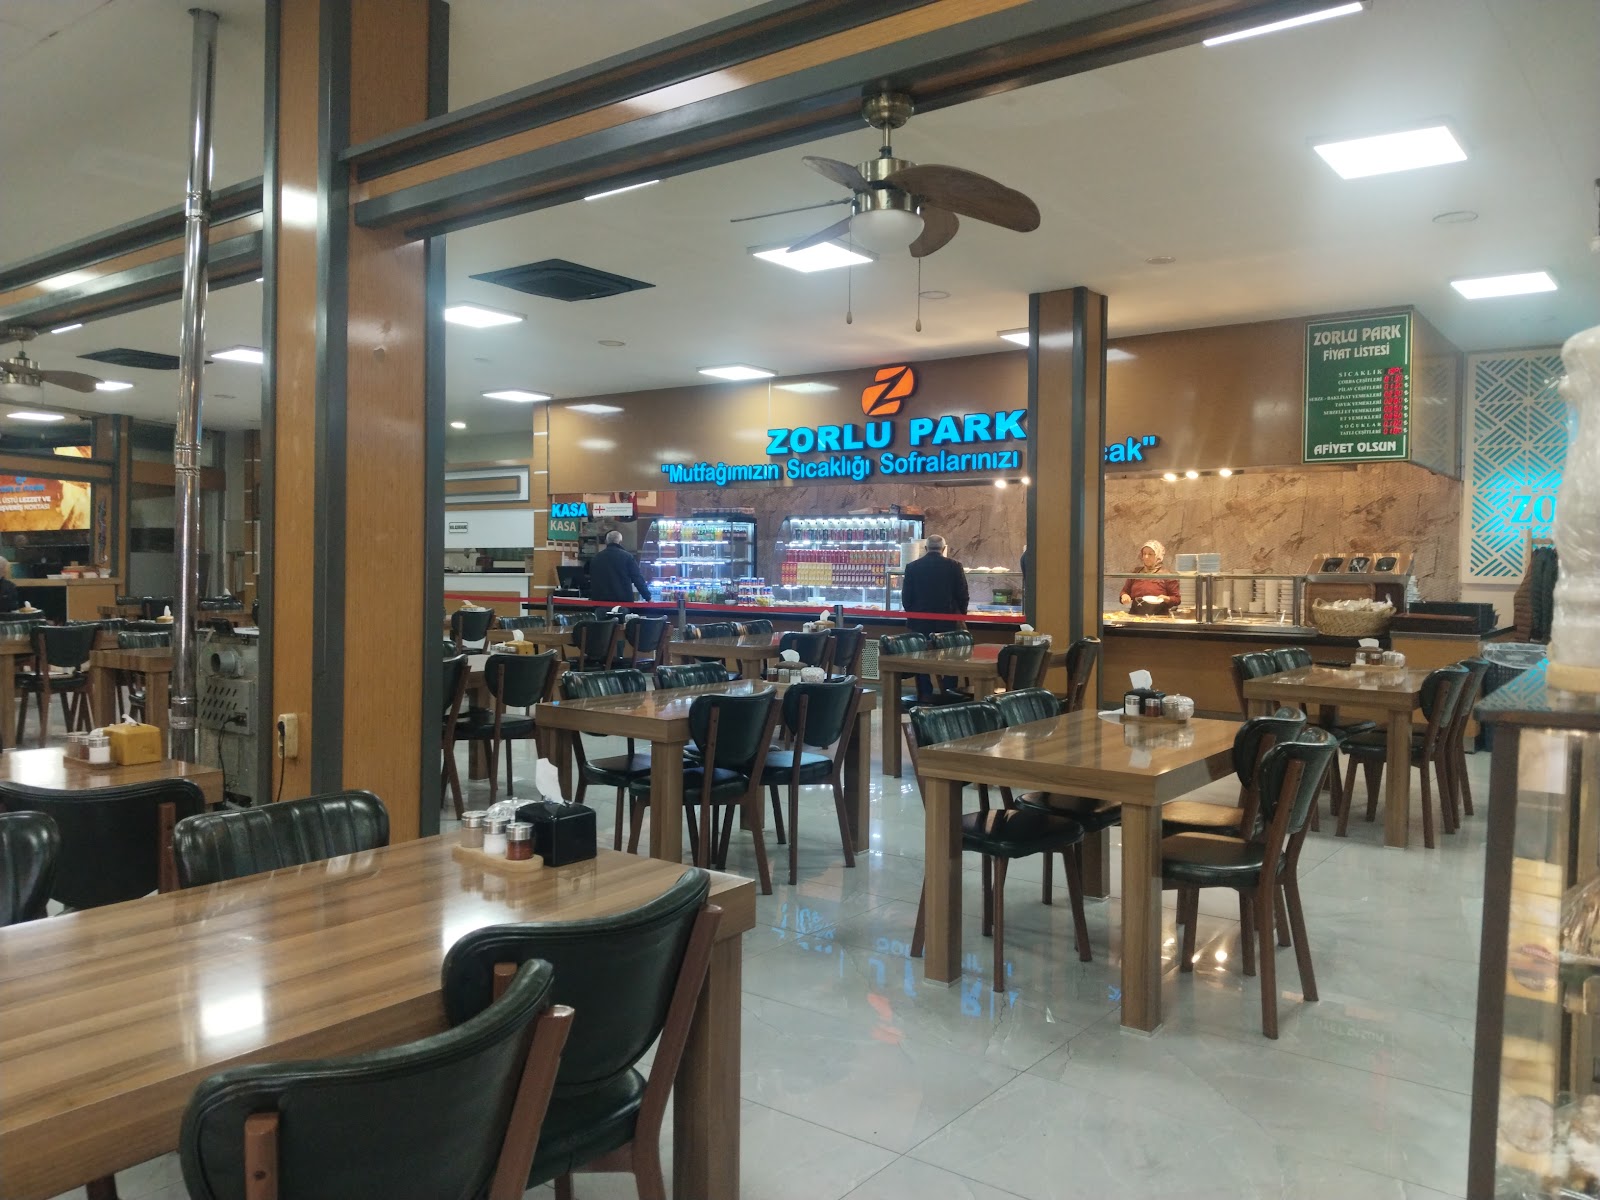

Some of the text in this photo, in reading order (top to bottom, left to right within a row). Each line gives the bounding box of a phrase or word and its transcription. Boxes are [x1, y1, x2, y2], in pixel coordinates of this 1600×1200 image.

[1313, 324, 1402, 346] ZORLU PARK
[1323, 342, 1390, 361] FİYAT LİSTESİ
[766, 409, 1028, 455] ZORLU PARK
[1313, 441, 1397, 455] AFİYET OLSUN
[661, 462, 780, 487] "Mutfağımızın
[786, 455, 871, 482] Sıcaklığı
[880, 449, 1019, 475] Sofralarınızı
[551, 502, 588, 518] KASA
[550, 519, 577, 532] KASA
